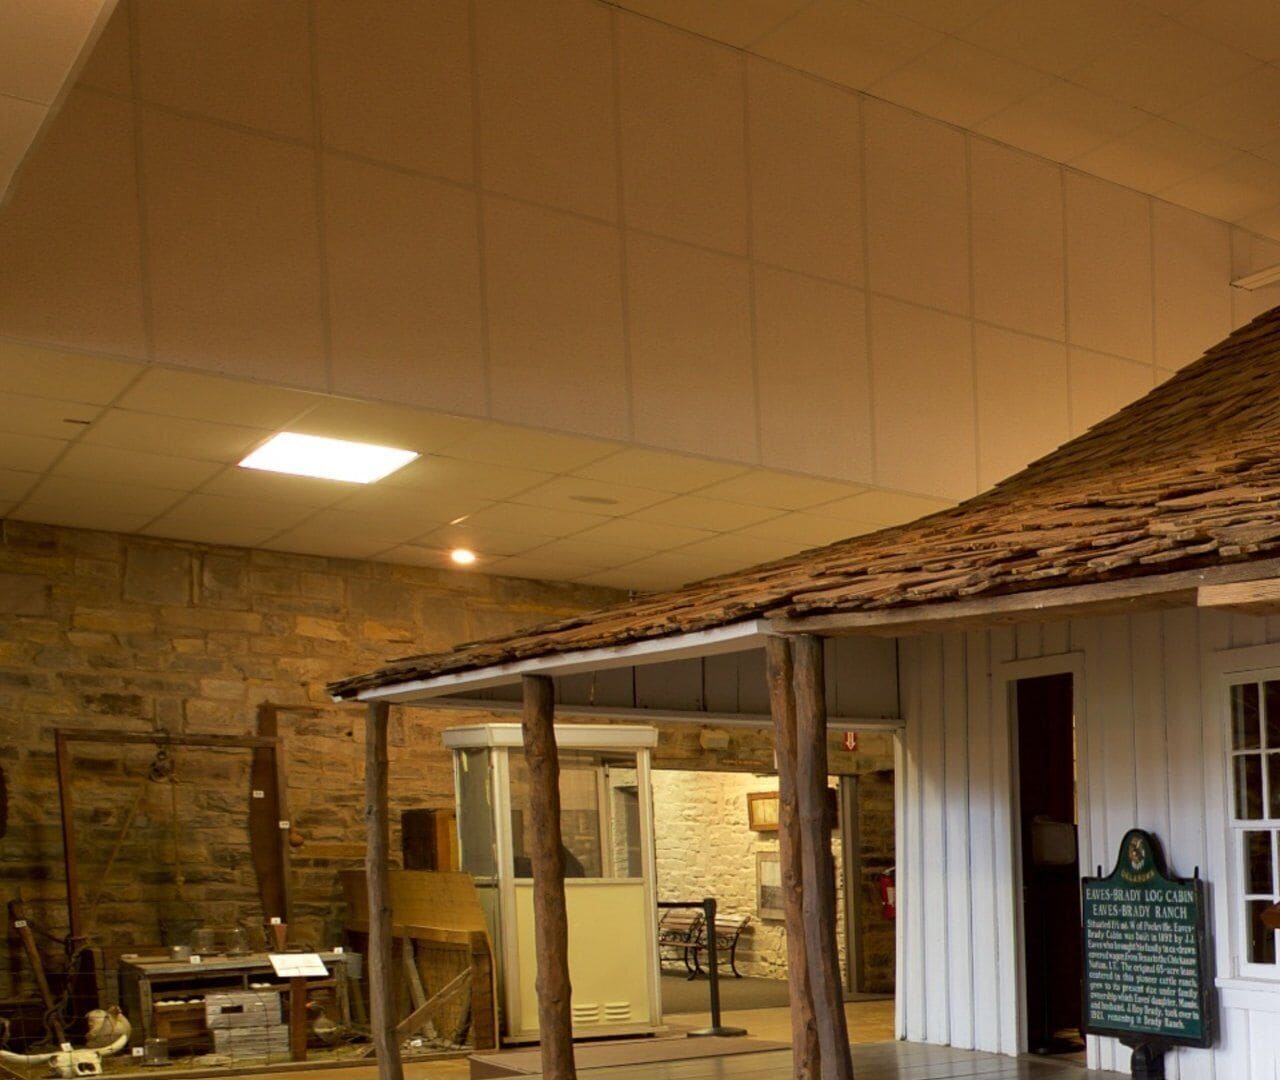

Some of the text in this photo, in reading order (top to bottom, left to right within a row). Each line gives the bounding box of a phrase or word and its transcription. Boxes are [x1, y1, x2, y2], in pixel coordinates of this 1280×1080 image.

[1086, 888, 1194, 903] EAVES-BRADY LOG CABIN
[1092, 904, 1188, 919] EAVES-BRADY RANCH
